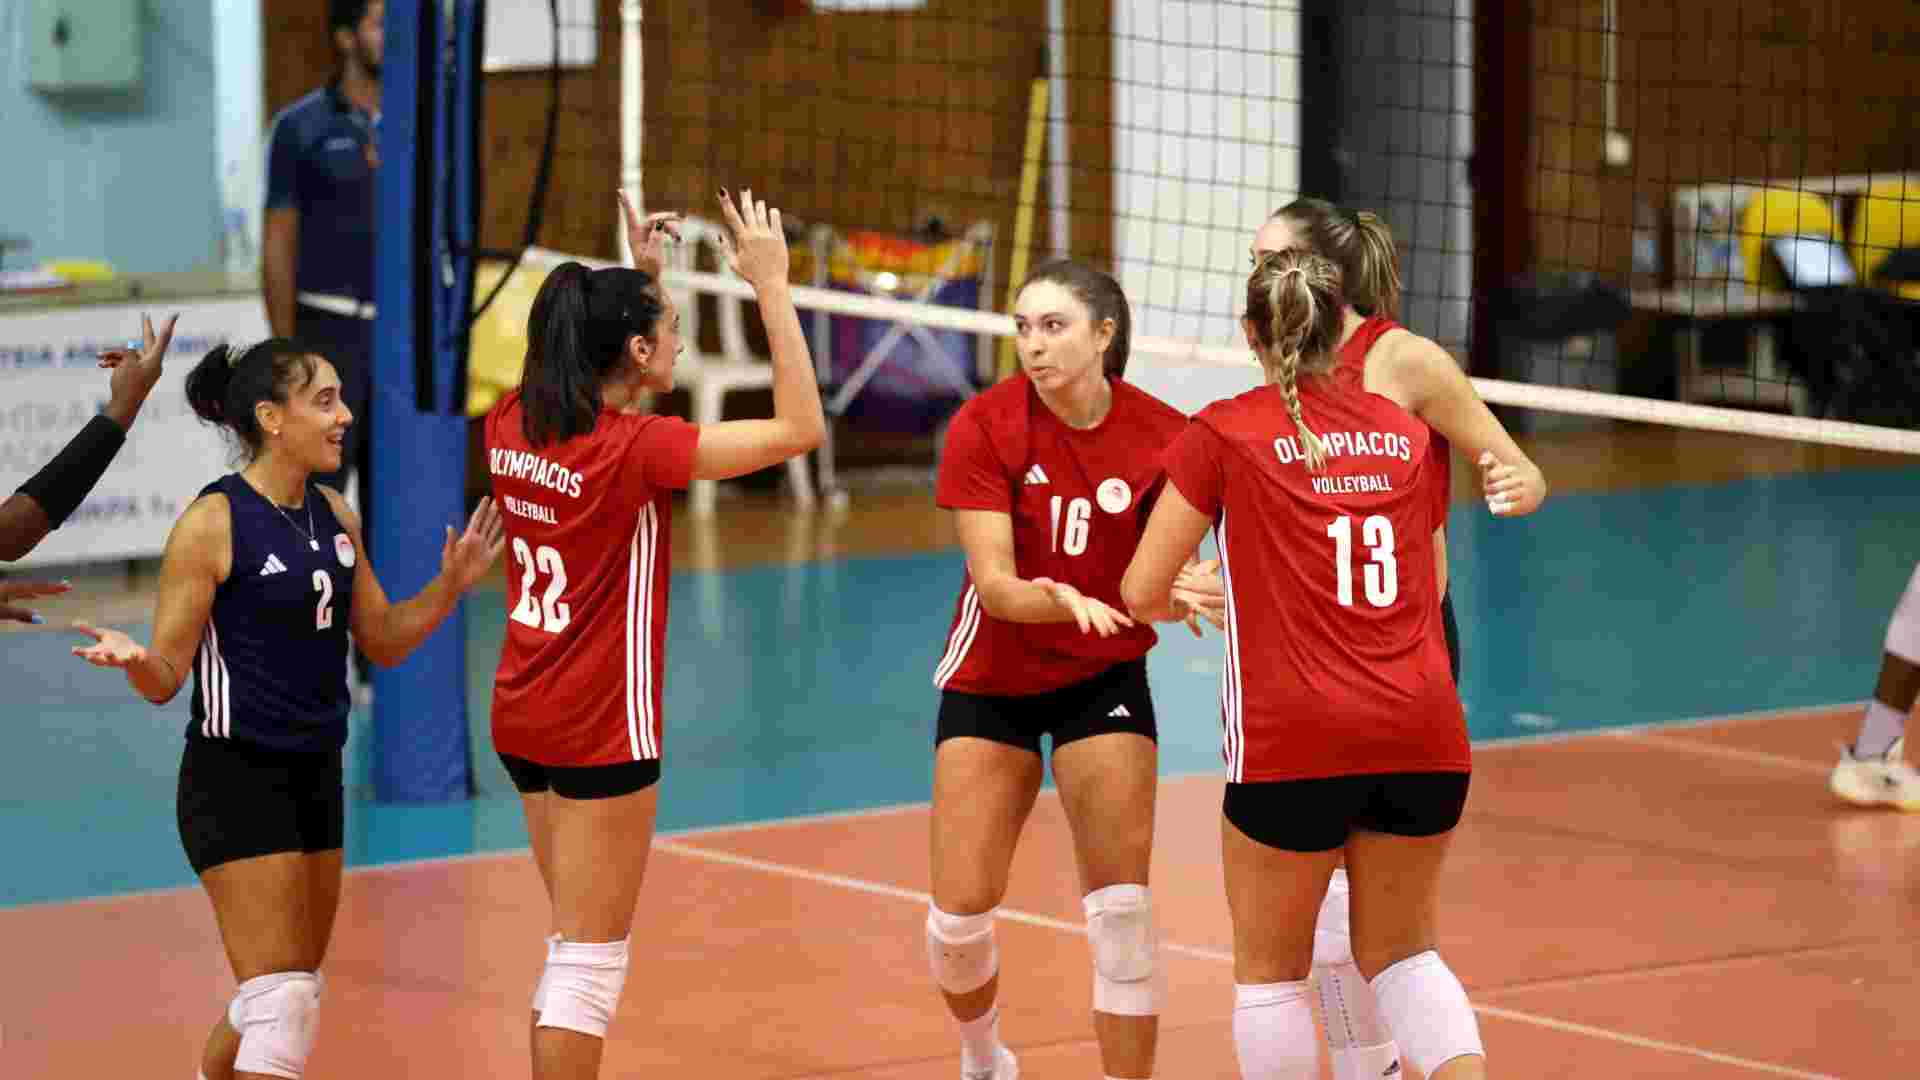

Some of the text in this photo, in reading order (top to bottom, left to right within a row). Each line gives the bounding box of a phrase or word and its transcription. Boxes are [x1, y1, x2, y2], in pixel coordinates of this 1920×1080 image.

[489, 447, 584, 498] OLYMPIACOS
[1273, 431, 1411, 464] OLMPIACOS
[503, 493, 560, 525] VOLLEYBALL
[1311, 473, 1393, 495] VOLLEYBALL
[1050, 495, 1092, 557] 16
[510, 536, 572, 634] 22
[1327, 514, 1399, 608] 13
[312, 569, 333, 632] 2
